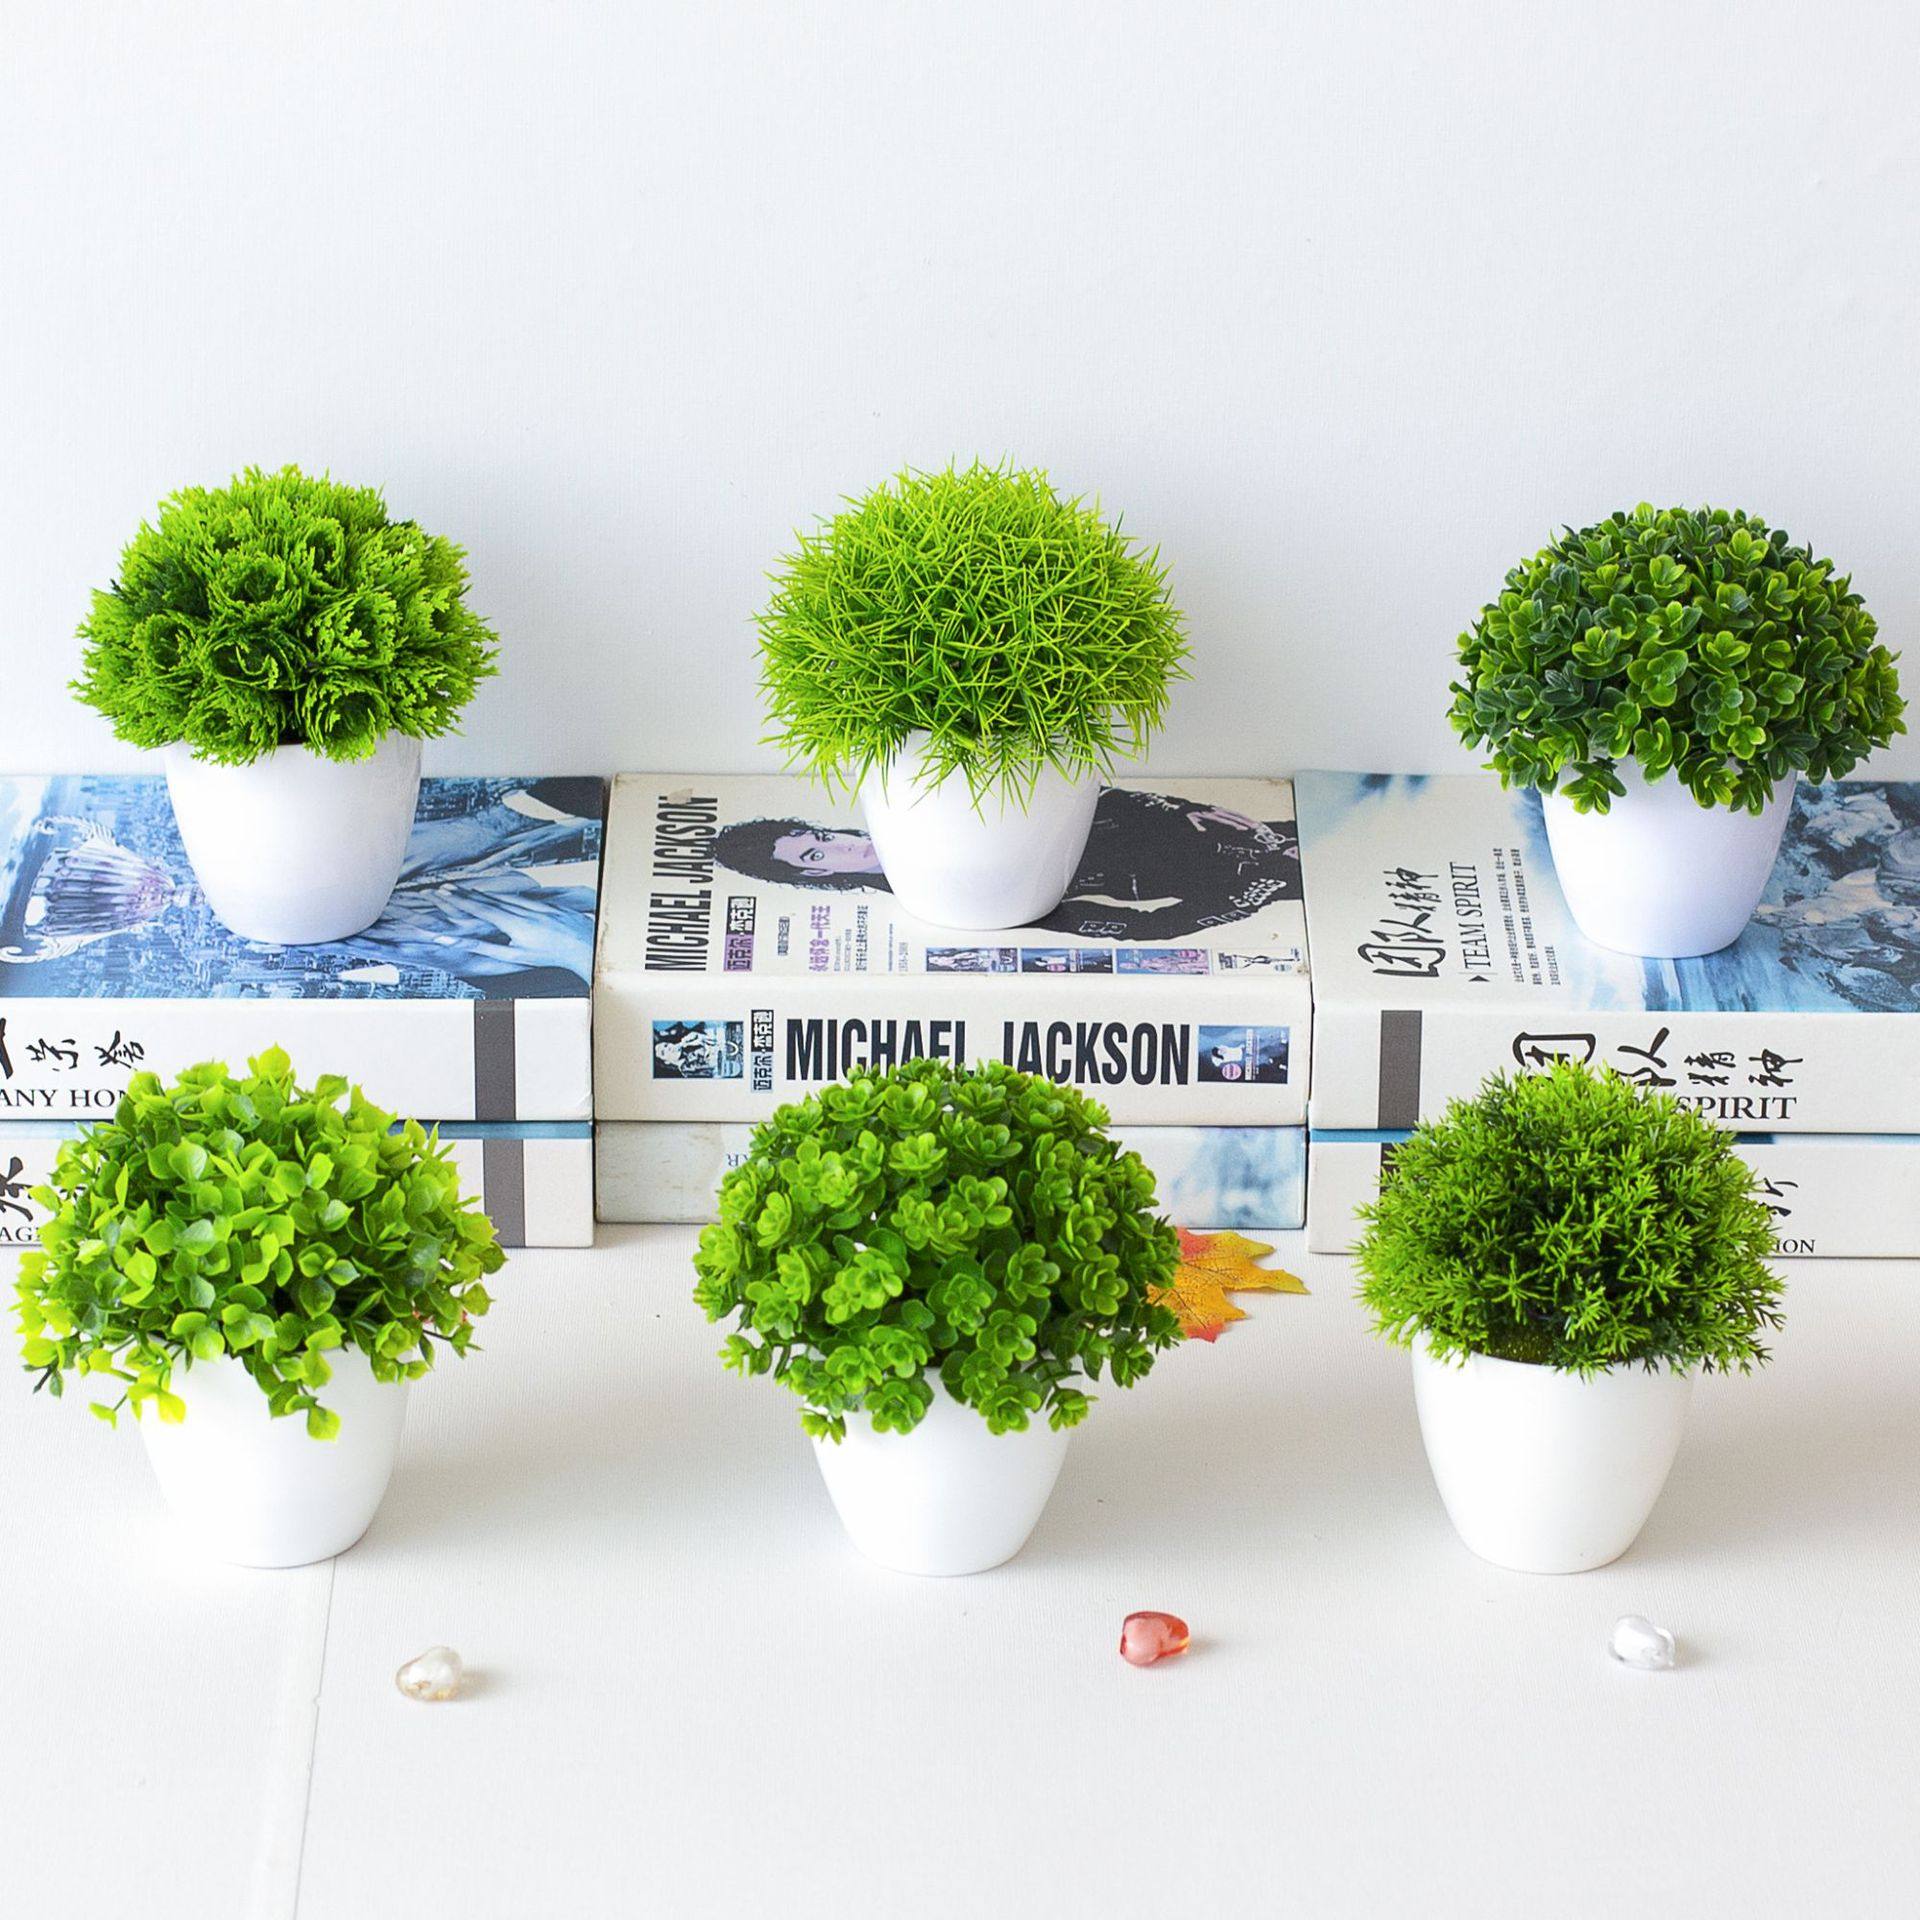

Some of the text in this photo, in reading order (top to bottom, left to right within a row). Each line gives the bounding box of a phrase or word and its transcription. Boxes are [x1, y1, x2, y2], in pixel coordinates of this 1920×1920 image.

[644, 795, 718, 971] MICHAEL JACKSON
[1357, 867, 1446, 978] 团队精神
[1449, 861, 1491, 969] TEAM SPIRIT
